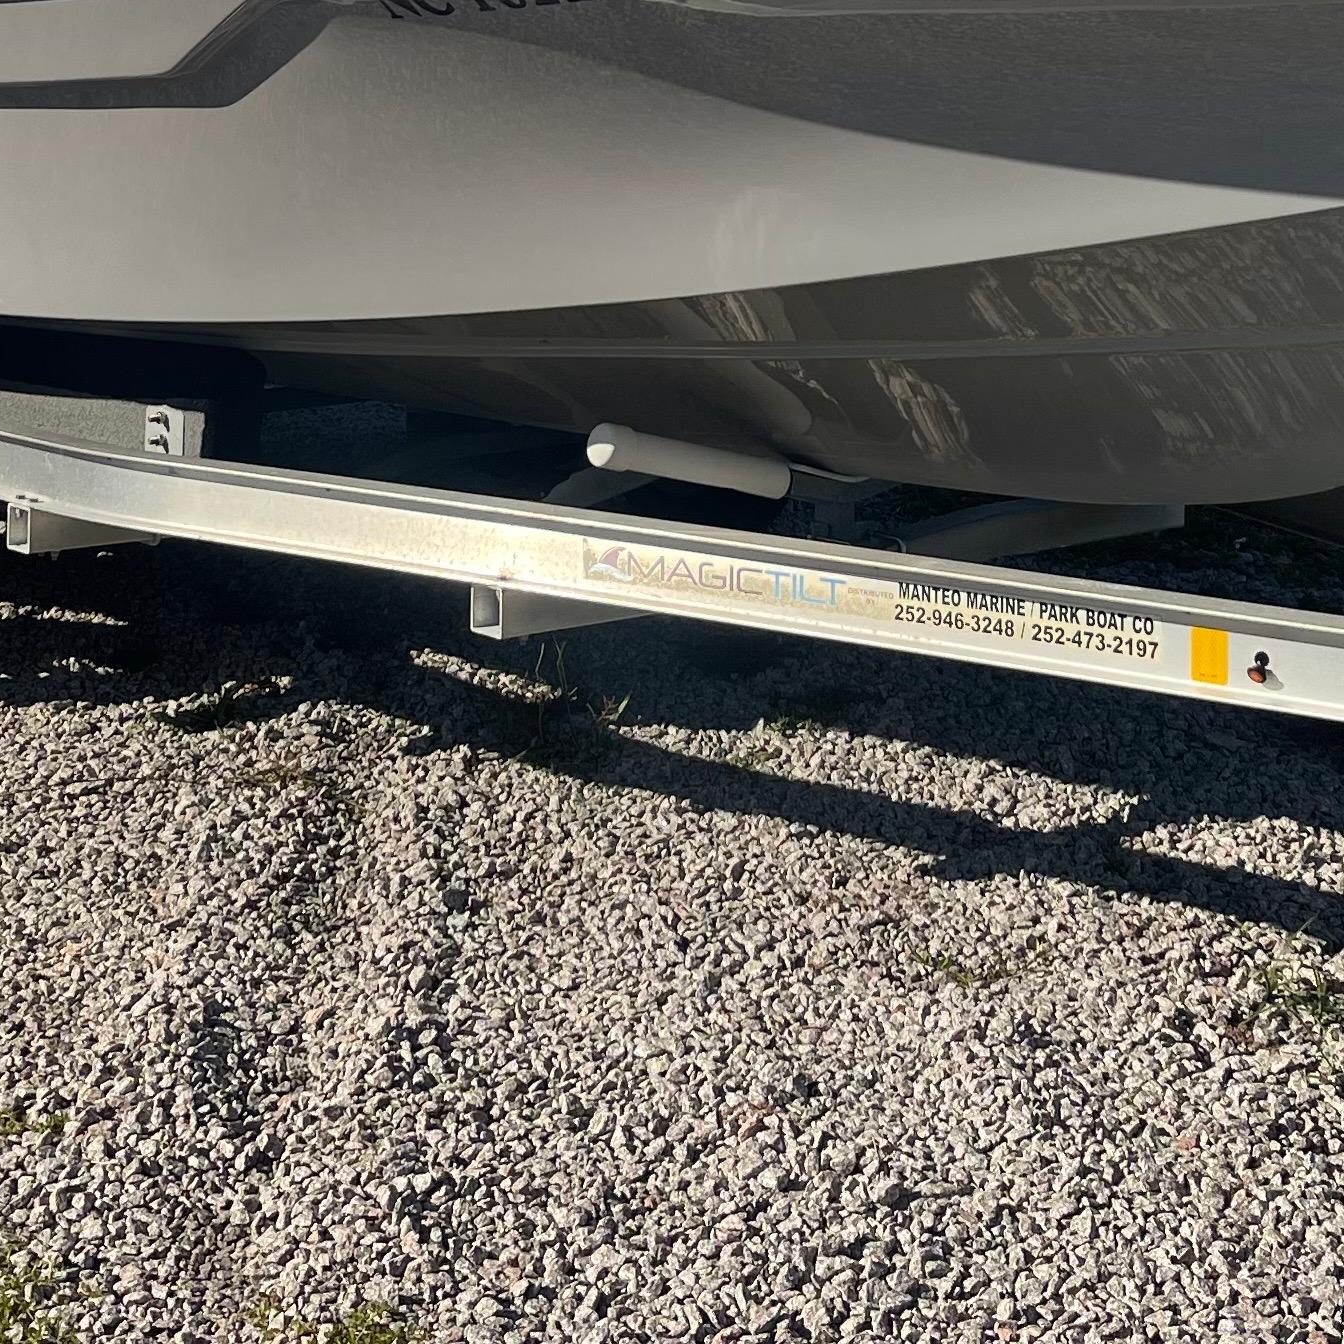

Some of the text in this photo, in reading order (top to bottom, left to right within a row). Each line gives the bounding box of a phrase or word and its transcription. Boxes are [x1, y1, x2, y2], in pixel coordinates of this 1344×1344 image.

[627, 551, 847, 607] MAGICTILT
[893, 603, 1015, 638] 252-946-3248
[1031, 623, 1159, 660] 252-473-2197
[898, 581, 962, 607] MANTEO
[966, 591, 1026, 617] MARINE
[1039, 601, 1081, 625] PARK
[1085, 608, 1128, 632] BOAT
[1132, 615, 1154, 636] CO
